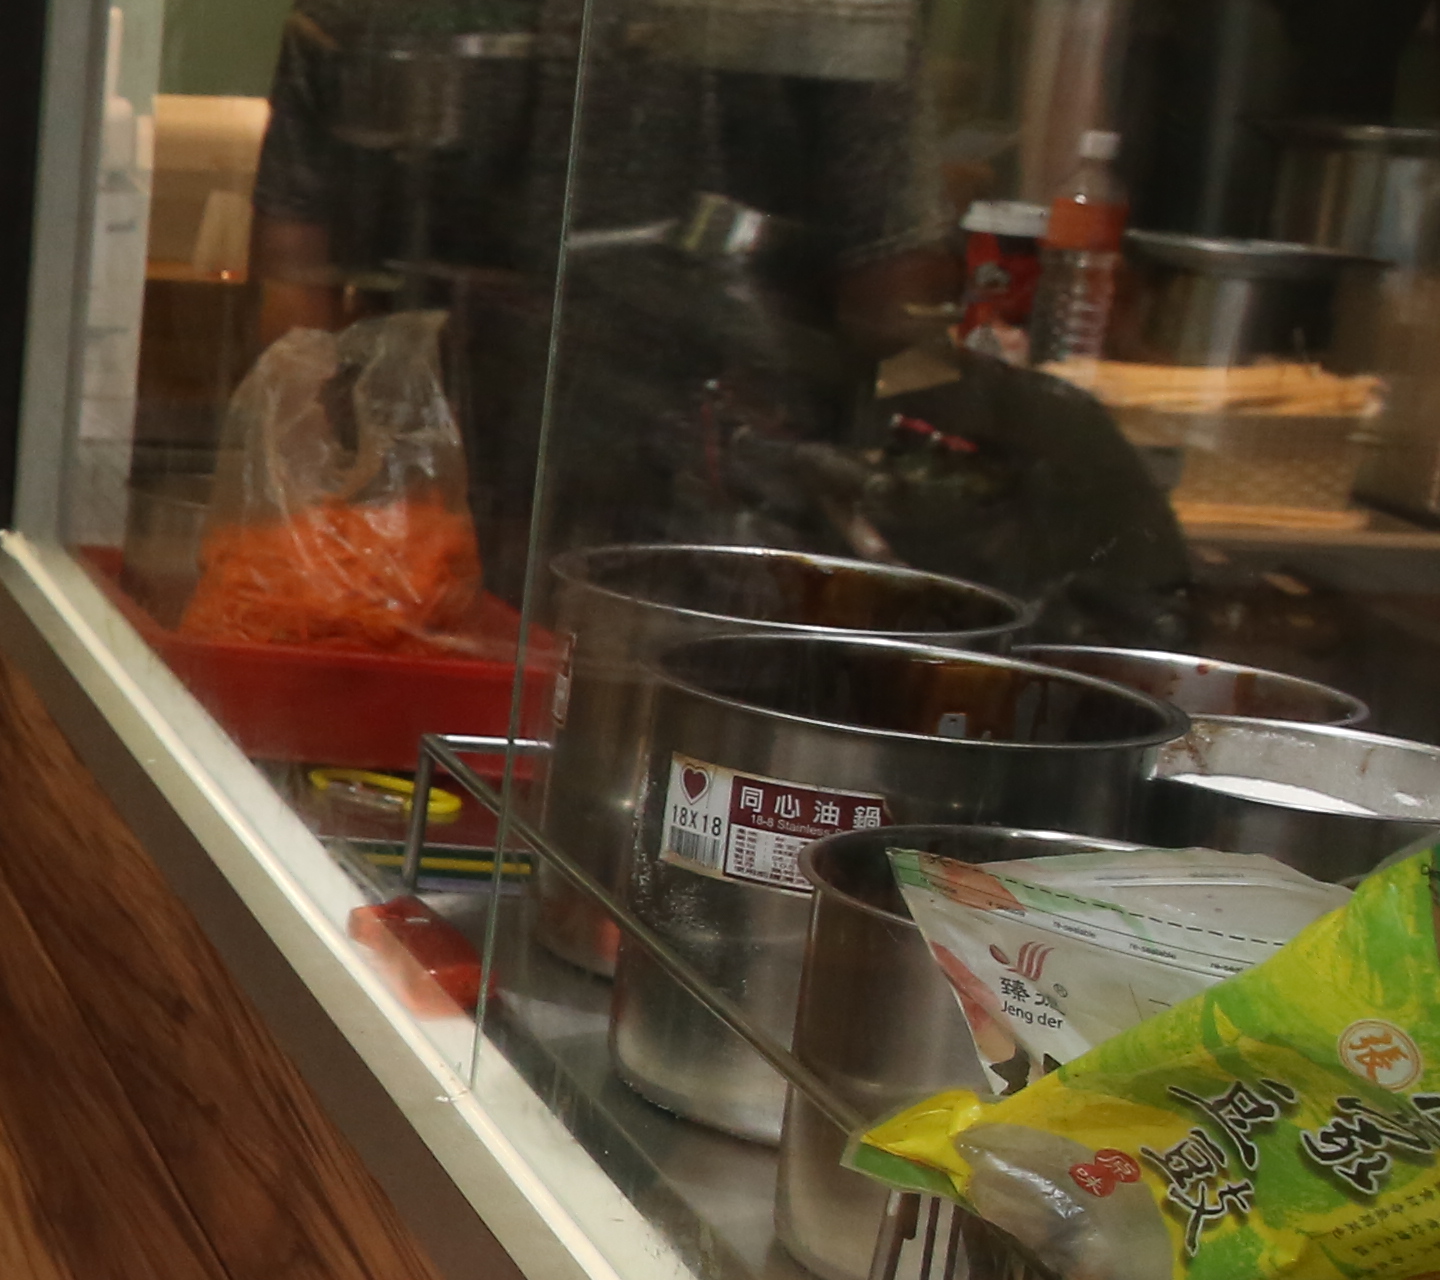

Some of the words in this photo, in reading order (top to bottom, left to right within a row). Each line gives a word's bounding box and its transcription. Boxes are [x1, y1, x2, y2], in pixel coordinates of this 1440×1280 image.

[740, 785, 880, 829] 同心油鍋
[777, 819, 831, 836] Stainless
[1001, 1000, 1033, 1025] Jeng
[1035, 1012, 1064, 1030] der
[1075, 1153, 1135, 1195] 原味
